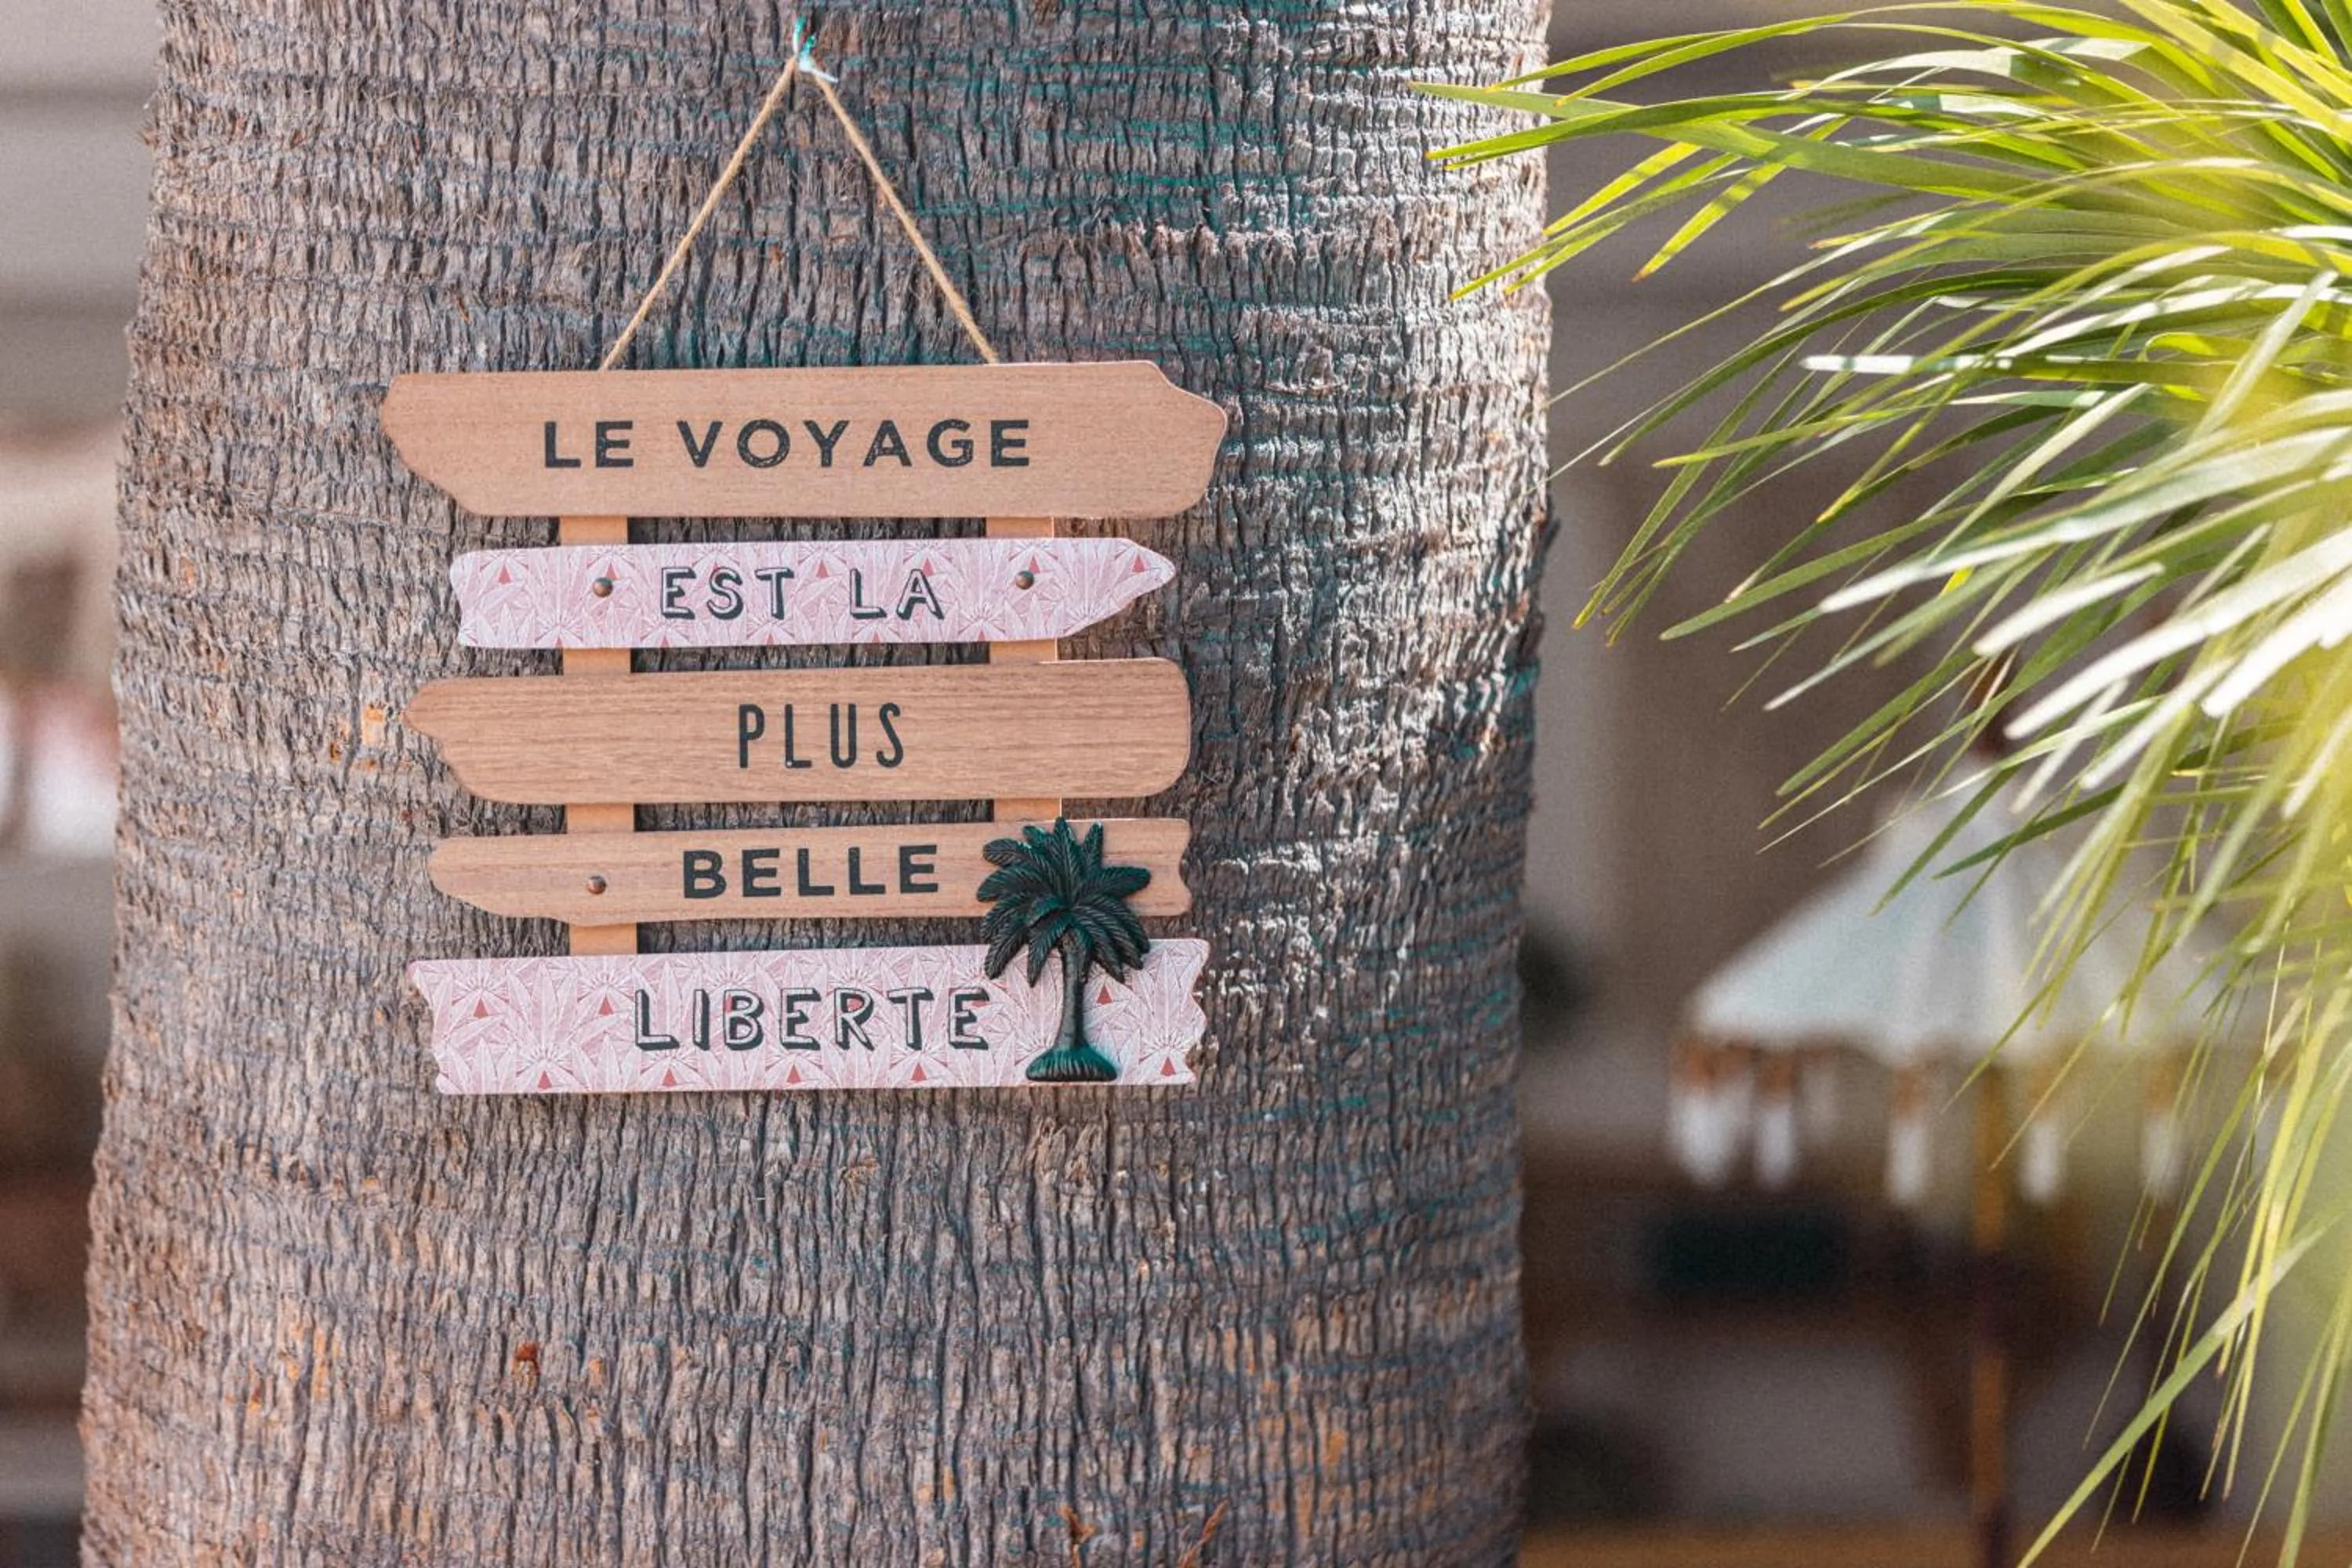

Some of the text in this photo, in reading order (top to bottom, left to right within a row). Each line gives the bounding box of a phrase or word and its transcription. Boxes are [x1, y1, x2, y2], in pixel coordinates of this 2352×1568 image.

[545, 418, 1031, 469] LE VOYAGE
[660, 567, 946, 621] EST LA
[738, 702, 905, 770] PLUS
[682, 844, 940, 900] BELLE
[633, 986, 992, 1052] LIBERTE
